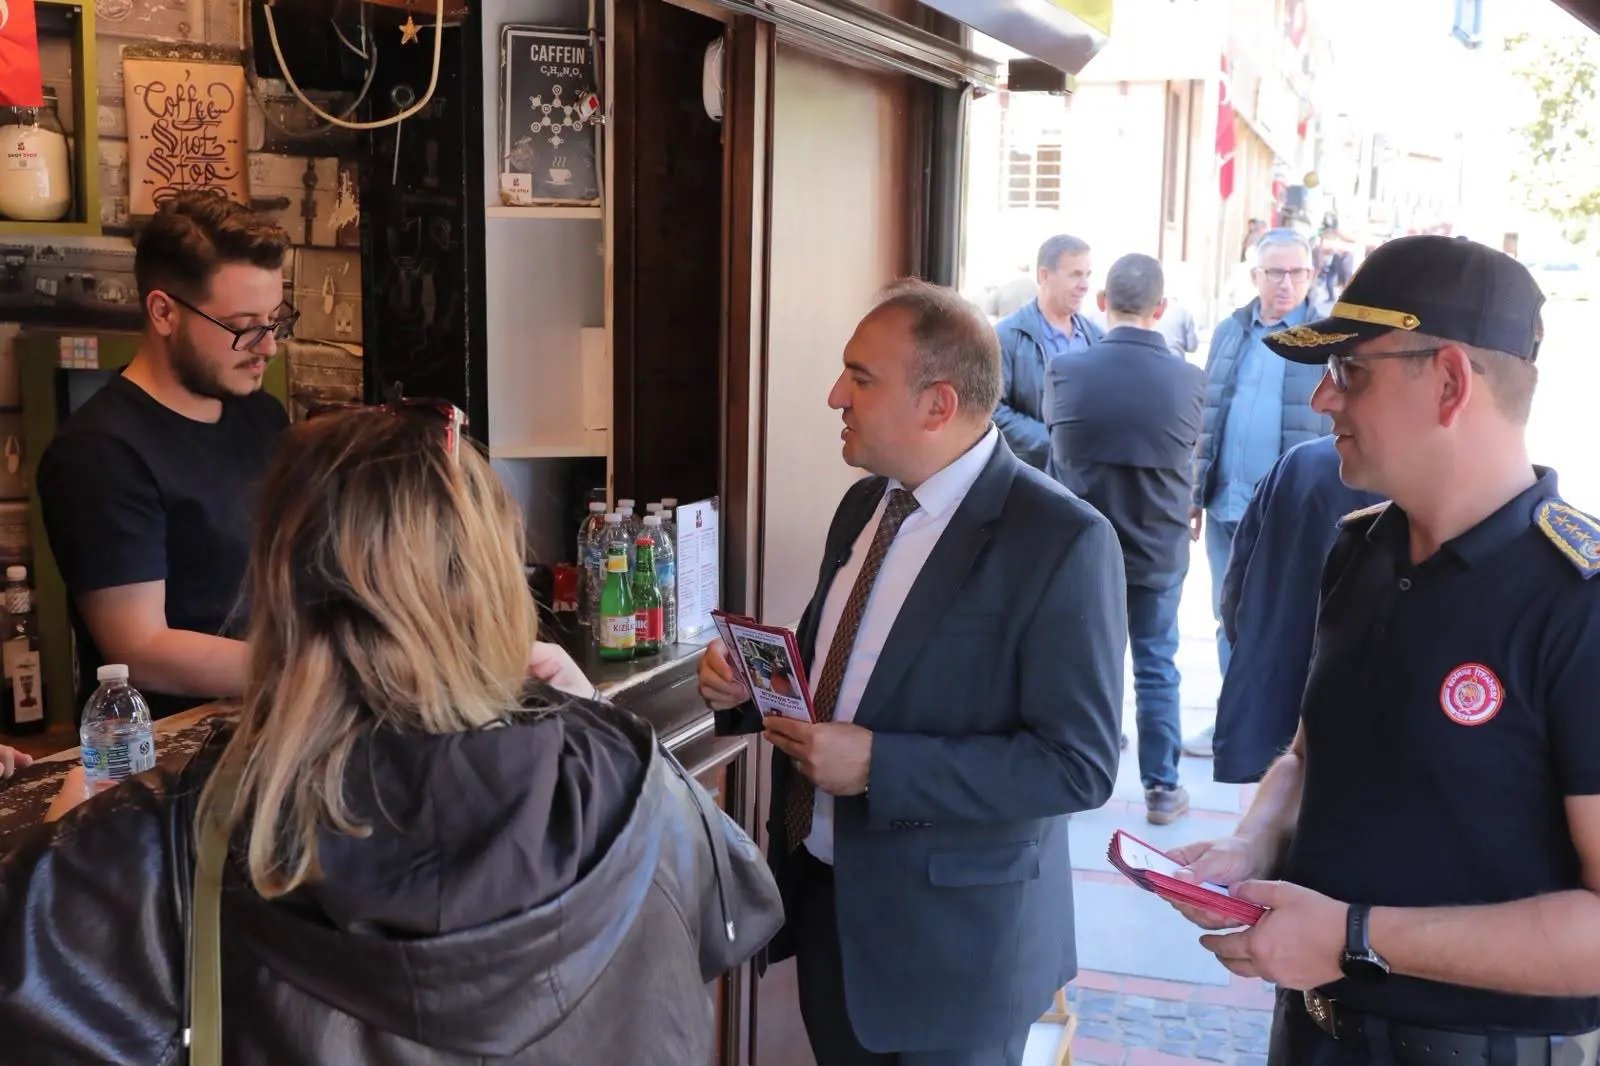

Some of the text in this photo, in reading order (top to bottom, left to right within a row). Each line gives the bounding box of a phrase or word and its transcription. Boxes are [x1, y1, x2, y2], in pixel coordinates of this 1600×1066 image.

[530, 44, 585, 65] CAFFEIN
[134, 81, 235, 126] Coffee
[151, 118, 225, 157] Shot
[146, 147, 239, 191] Stop
